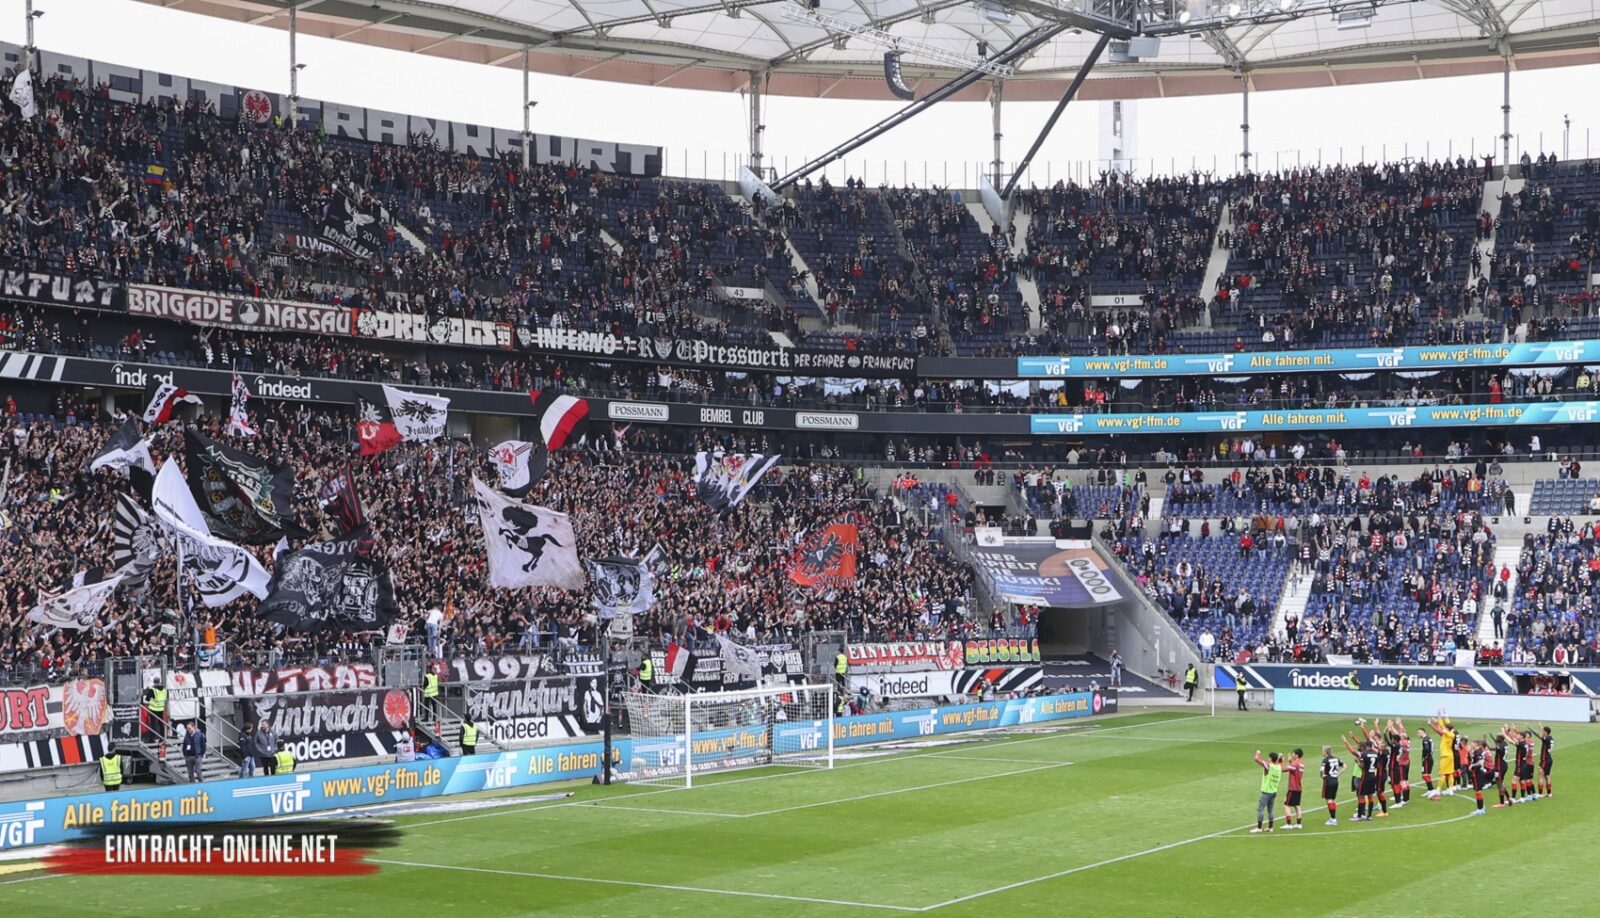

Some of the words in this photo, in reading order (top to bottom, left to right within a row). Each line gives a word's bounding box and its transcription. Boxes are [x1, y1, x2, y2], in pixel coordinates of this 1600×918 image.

[734, 289, 745, 297] 43
[1114, 296, 1125, 305] 01
[129, 288, 234, 322] BRIGADE
[264, 304, 350, 334] NASSAU
[537, 327, 617, 355] INFERNO
[692, 339, 790, 368] Presswerk
[1251, 355, 1272, 367] Alle
[1276, 353, 1311, 366] fahren
[1313, 352, 1335, 365] mit.
[1377, 349, 1404, 368] VGF
[1419, 347, 1509, 362] www.vgf-ffm.de
[1556, 341, 1585, 361] VGF
[794, 353, 811, 368] PER
[862, 354, 915, 371] FRANKFURT
[1045, 357, 1071, 376] VGF
[1085, 357, 1168, 372] www.vgf-ffm.de
[1208, 354, 1234, 373] VGF
[256, 377, 311, 399] indeed
[614, 405, 663, 418] POSSMANN
[701, 408, 733, 425] BEMBEL
[742, 410, 764, 426] CLUB
[802, 415, 853, 427] POSSMANN
[1221, 411, 1247, 430] VGF
[1262, 413, 1284, 425] Alle
[1287, 411, 1323, 424] fahren
[1326, 411, 1348, 424] mit.
[1389, 408, 1416, 426] VGF
[1431, 406, 1522, 421] www.vgf-ffm.de
[1568, 402, 1597, 421] VGF
[1058, 412, 1083, 432] VGF
[1097, 416, 1181, 429] www.vgf-ffm.de
[847, 640, 946, 660] EINTRACHT
[232, 663, 377, 697] ULTRAS
[452, 655, 540, 690] 1997
[1370, 674, 1397, 687] Job
[1407, 675, 1454, 688] finden
[878, 675, 928, 696] indeed
[254, 693, 379, 739] Eintracht
[919, 709, 938, 735] VGF
[942, 706, 1000, 726] www.vgf-ffm.de
[488, 717, 548, 742] indeed
[849, 721, 876, 738] fahren
[878, 719, 895, 735] mit.
[284, 734, 346, 762] ndeed
[486, 752, 518, 788] VGF
[528, 753, 553, 775] Alle
[557, 748, 597, 772] fahren
[1329, 761, 1340, 775] 23
[1367, 757, 1377, 772] 2
[322, 766, 441, 798] www.vgf-ffm.de
[270, 774, 312, 814] VGF
[63, 803, 104, 830] Alle
[111, 798, 173, 823] fahren
[180, 790, 214, 815] mit.
